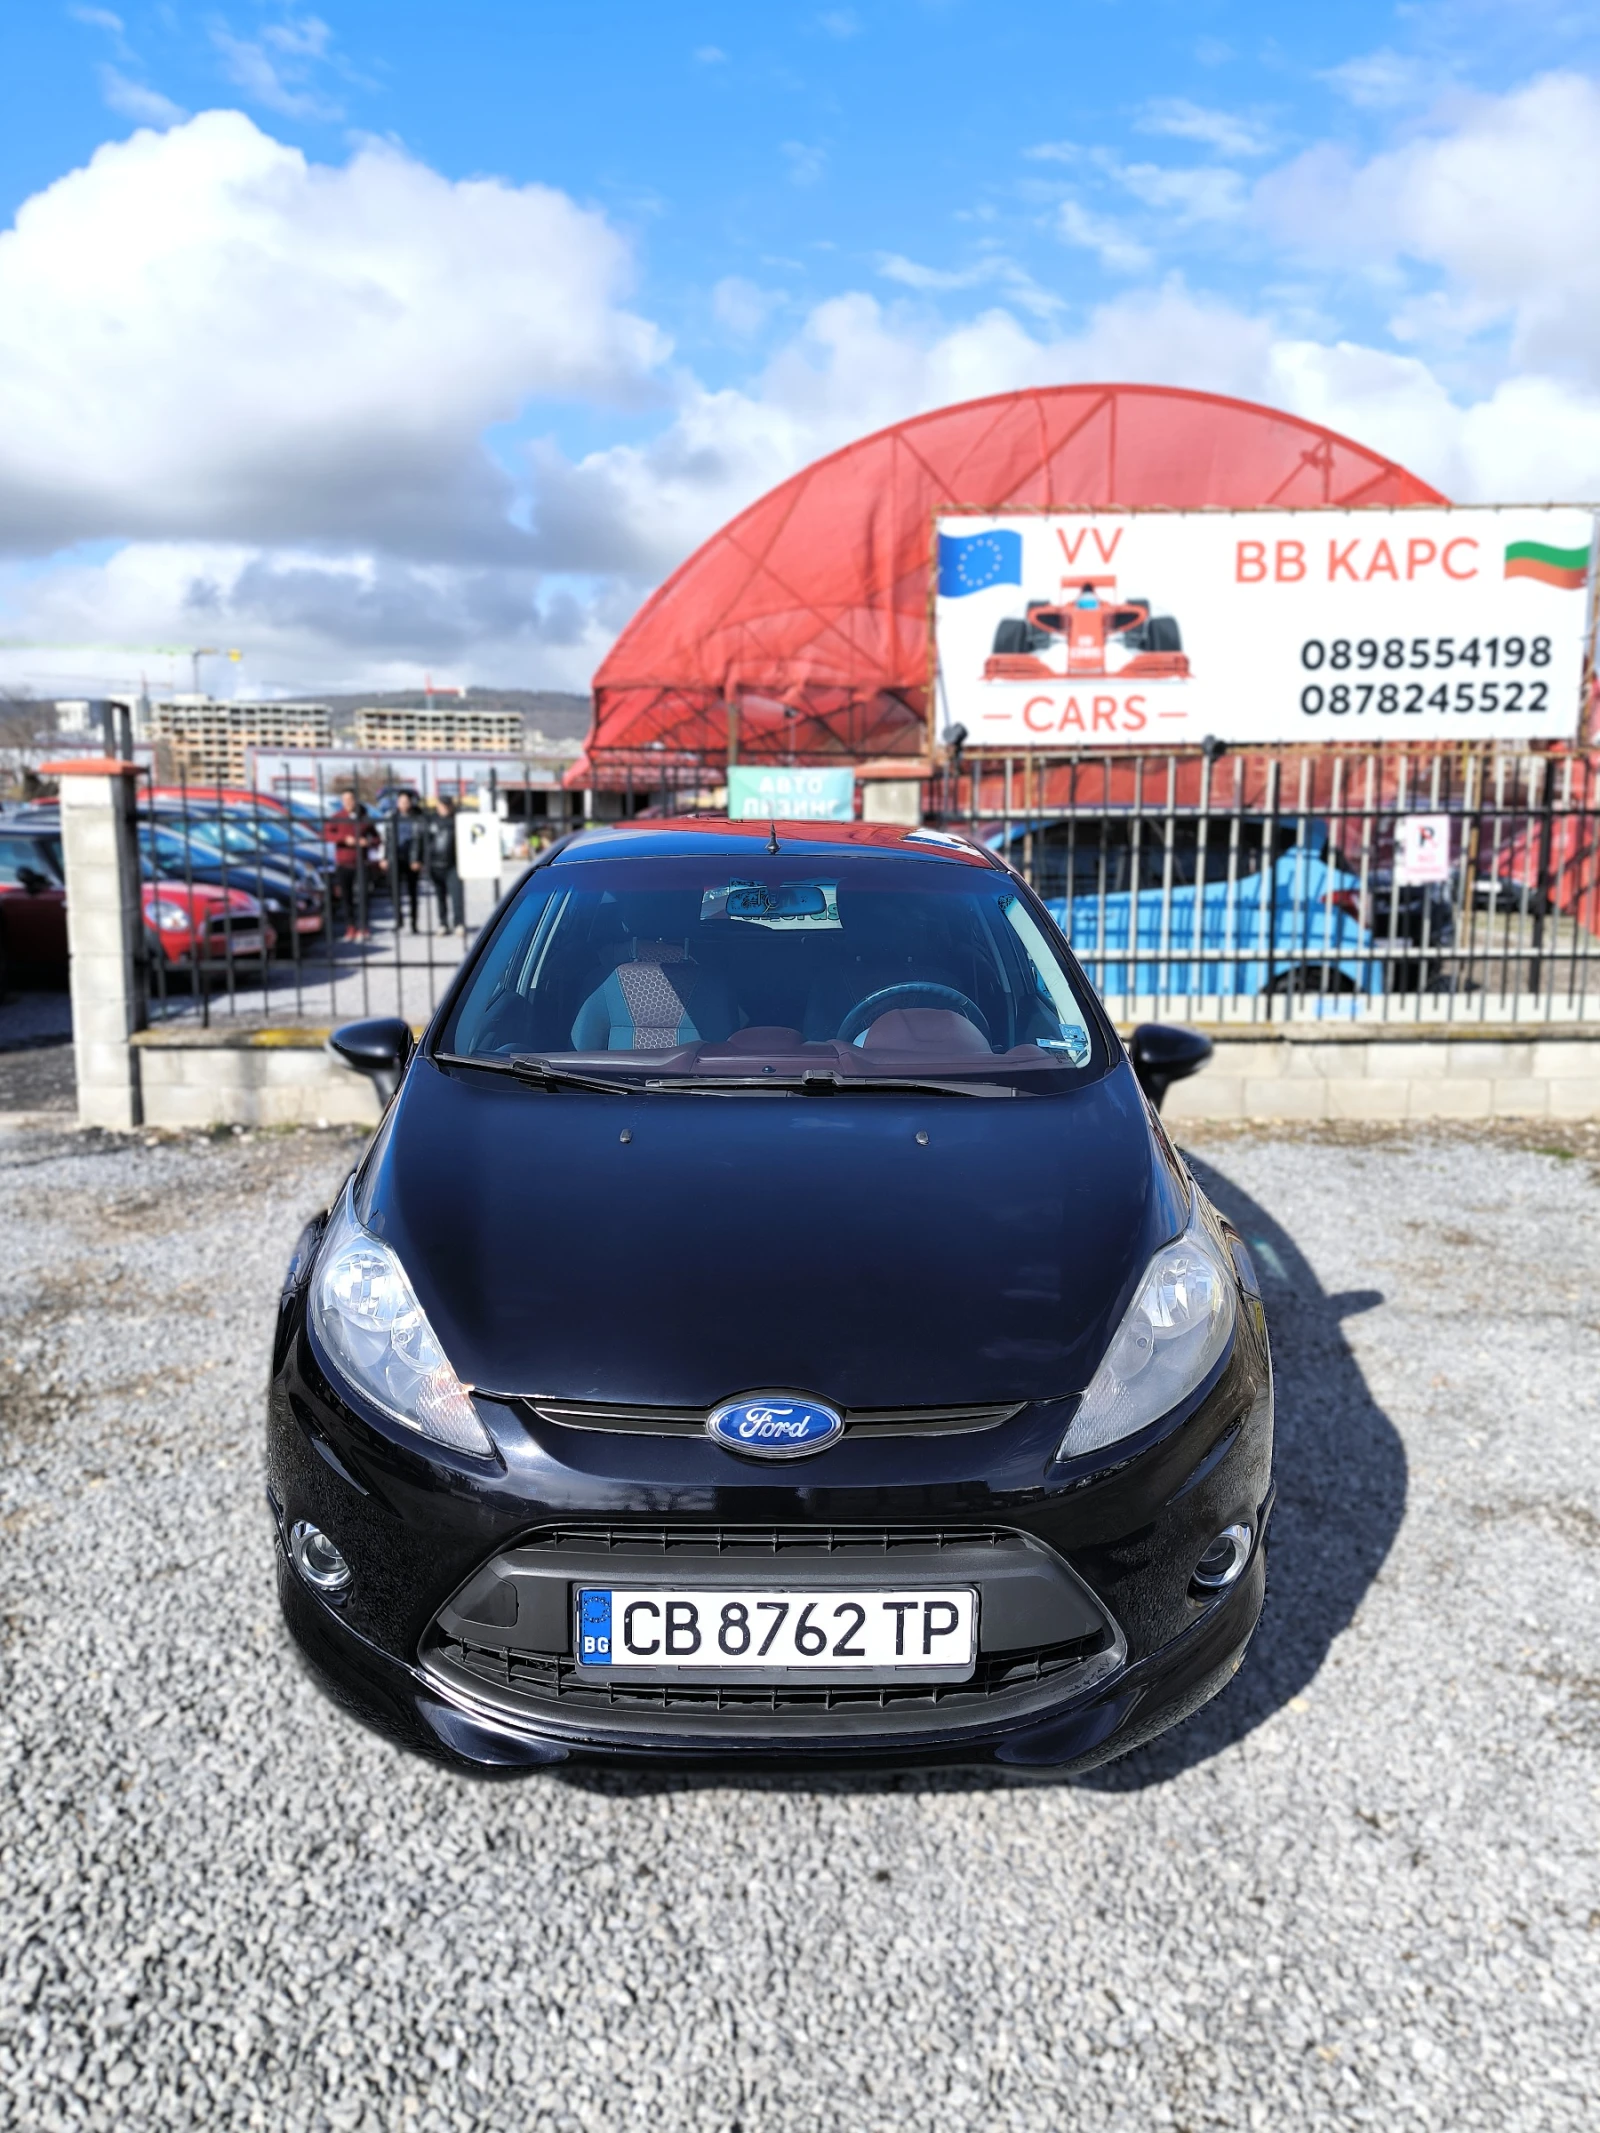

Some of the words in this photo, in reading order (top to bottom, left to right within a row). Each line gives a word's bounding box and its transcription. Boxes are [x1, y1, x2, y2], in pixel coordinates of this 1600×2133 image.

[1057, 527, 1123, 565] VV
[1235, 540, 1307, 583] ВВ
[1327, 536, 1479, 582] КАРС
[1301, 636, 1551, 670] 0898554198
[1023, 694, 1147, 733] CARS
[1301, 681, 1548, 715] 0878245522
[758, 775, 824, 794] АВТО
[739, 1407, 811, 1438] Ford
[584, 1636, 609, 1654] BG
[623, 1601, 702, 1656] CB
[717, 1601, 866, 1657] 8762
[882, 1600, 959, 1656] TP
